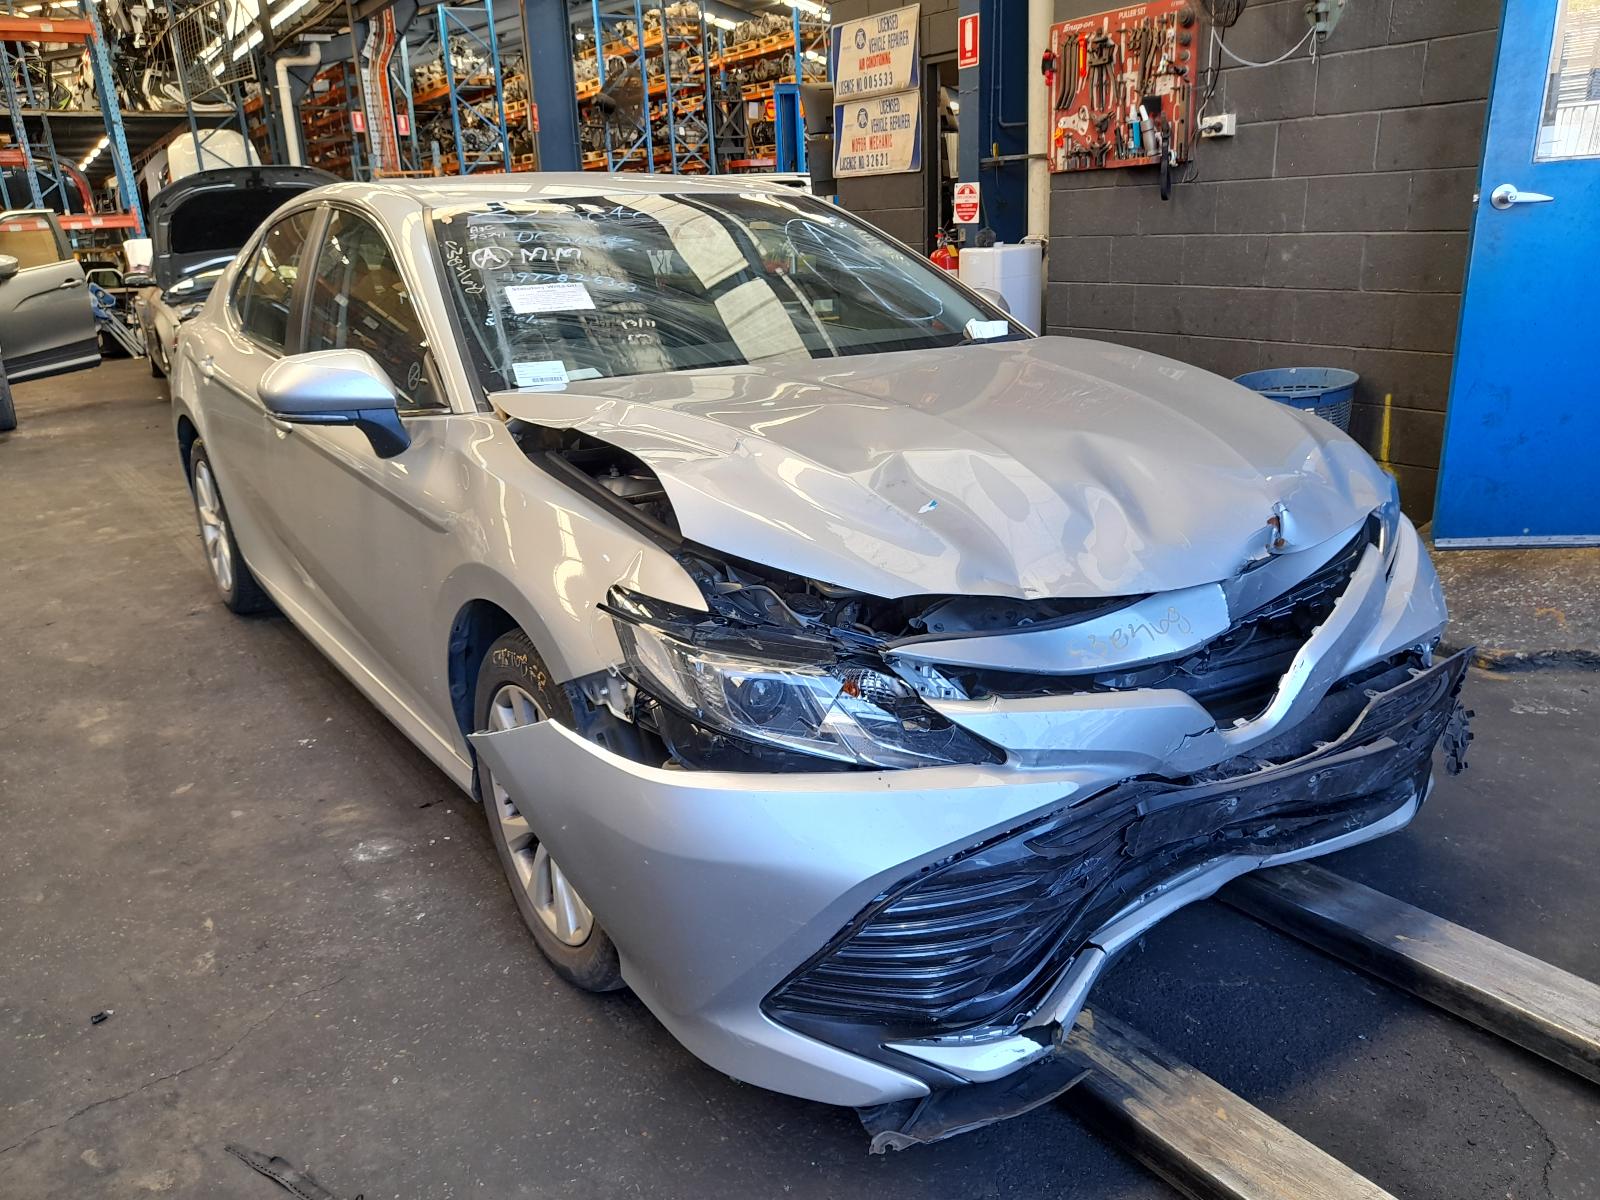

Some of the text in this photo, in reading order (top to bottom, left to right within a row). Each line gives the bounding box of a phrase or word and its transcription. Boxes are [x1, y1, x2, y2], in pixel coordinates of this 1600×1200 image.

[1118, 6, 1147, 19] PULLER SET
[877, 14, 898, 33] LICENSED
[1063, 20, 1095, 33] Snap-on
[869, 30, 909, 54] VEHICLE REPAIRER
[864, 72, 893, 90] 005533
[879, 98, 900, 115] LICENSED
[871, 114, 911, 133] VEHICLE REPAIRER
[865, 152, 889, 168] 32621
